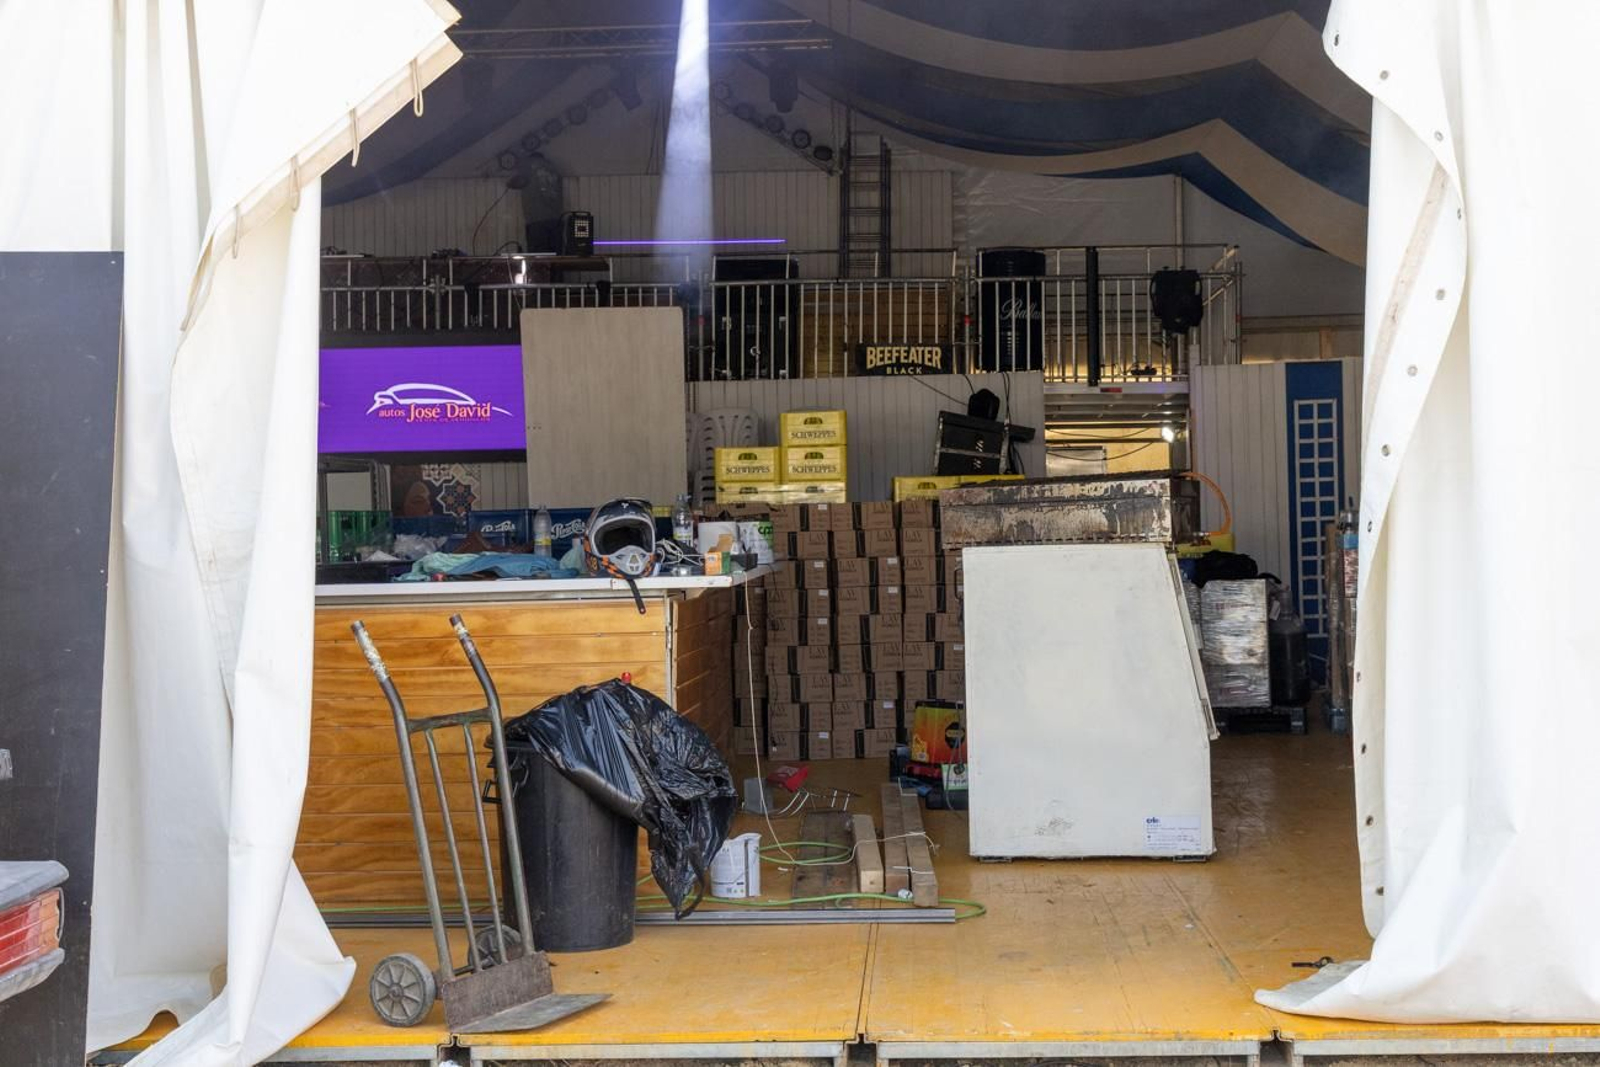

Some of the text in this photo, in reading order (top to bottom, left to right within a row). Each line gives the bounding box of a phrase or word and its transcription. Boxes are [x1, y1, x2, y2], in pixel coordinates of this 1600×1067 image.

[866, 346, 942, 370] BEEFEATER
[886, 366, 923, 375] BLACK
[378, 401, 491, 423] autos José David
[790, 430, 837, 440] SCHWEPPES
[726, 465, 771, 475] SCHWEPPES
[791, 465, 837, 475] SCHWEPPES
